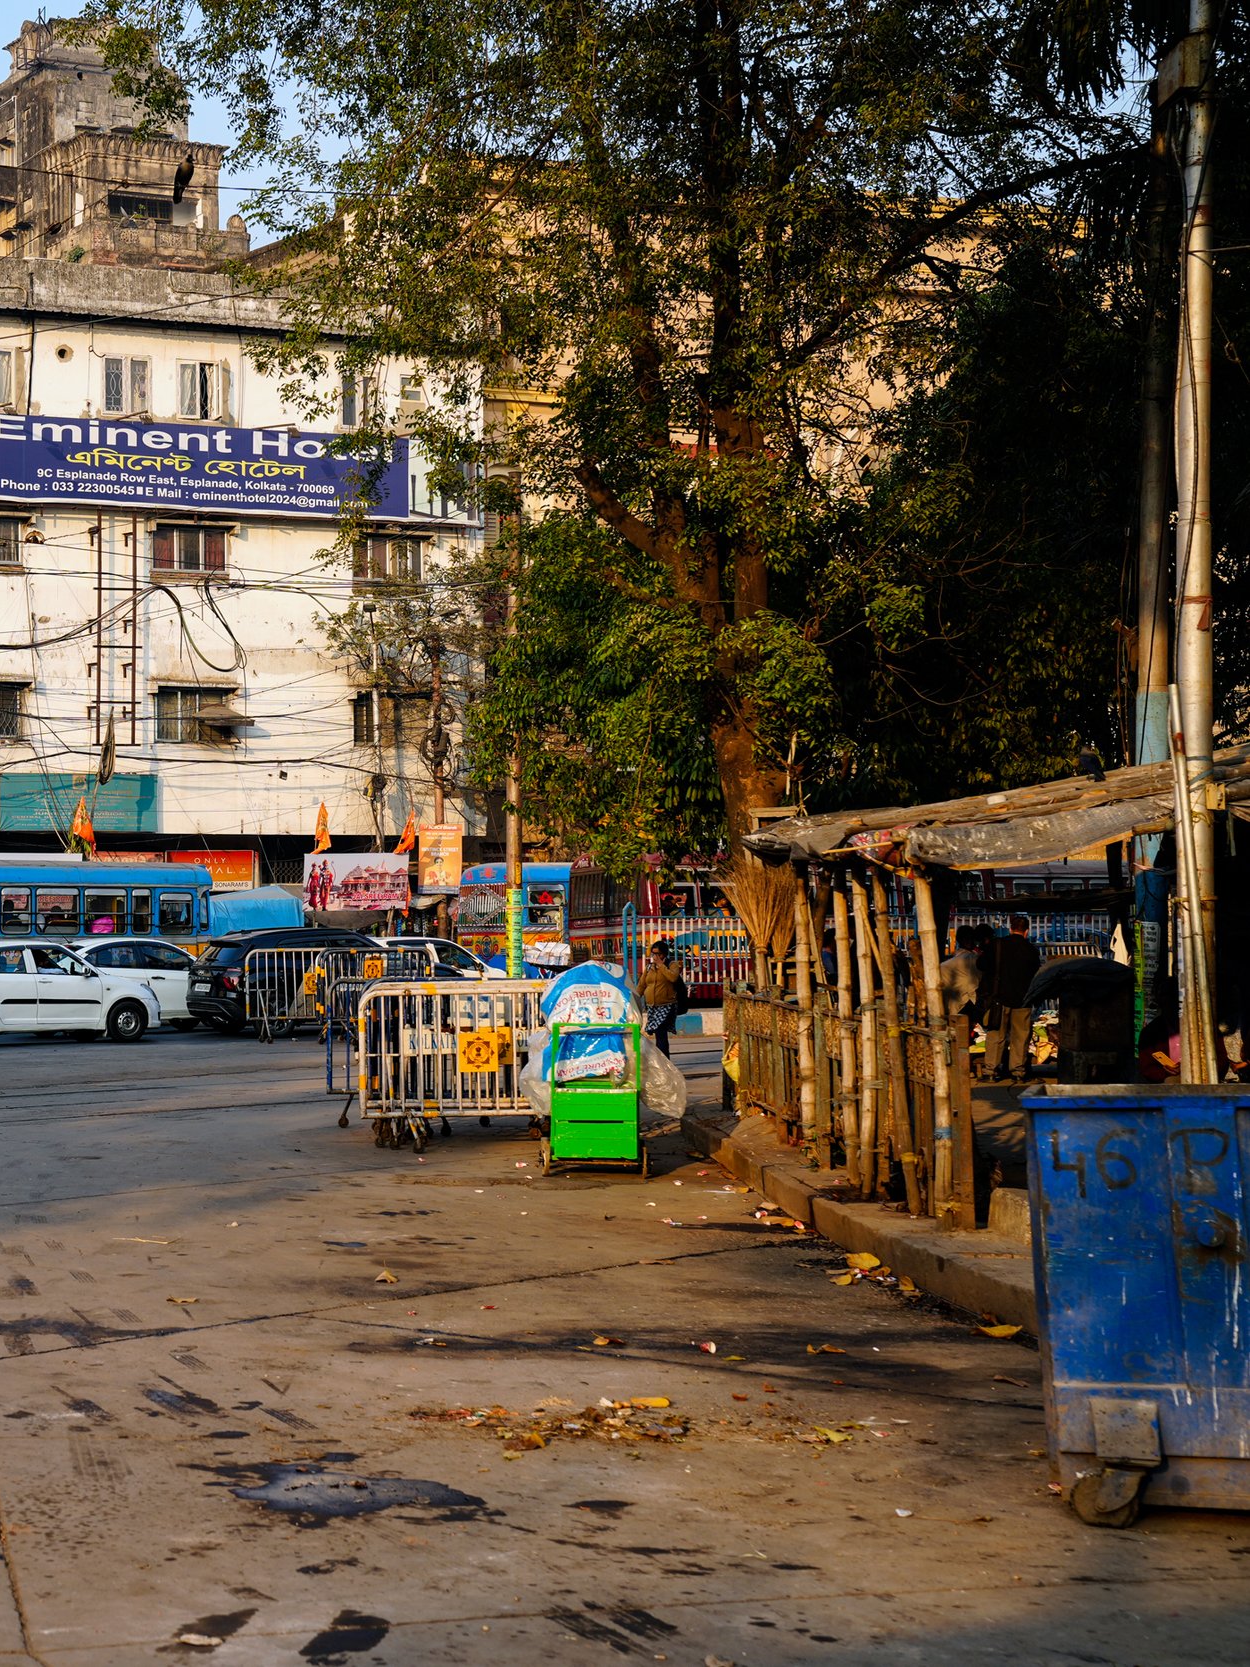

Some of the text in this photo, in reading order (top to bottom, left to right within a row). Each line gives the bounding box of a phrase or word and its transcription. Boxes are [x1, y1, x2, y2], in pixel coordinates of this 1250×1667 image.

[252, 430, 393, 463] Hoel
[205, 458, 307, 479] হোটেল
[0, 478, 41, 491] Phone
[52, 481, 74, 492] 033
[157, 488, 181, 499] Mail
[37, 468, 53, 478] 9C
[56, 469, 117, 482] Esplanade
[120, 471, 146, 483] Row
[148, 475, 177, 487] East,
[180, 477, 242, 491] Esplanade,
[245, 480, 287, 492] Kolkata
[297, 483, 335, 495] 700069
[193, 857, 227, 865] ONLY
